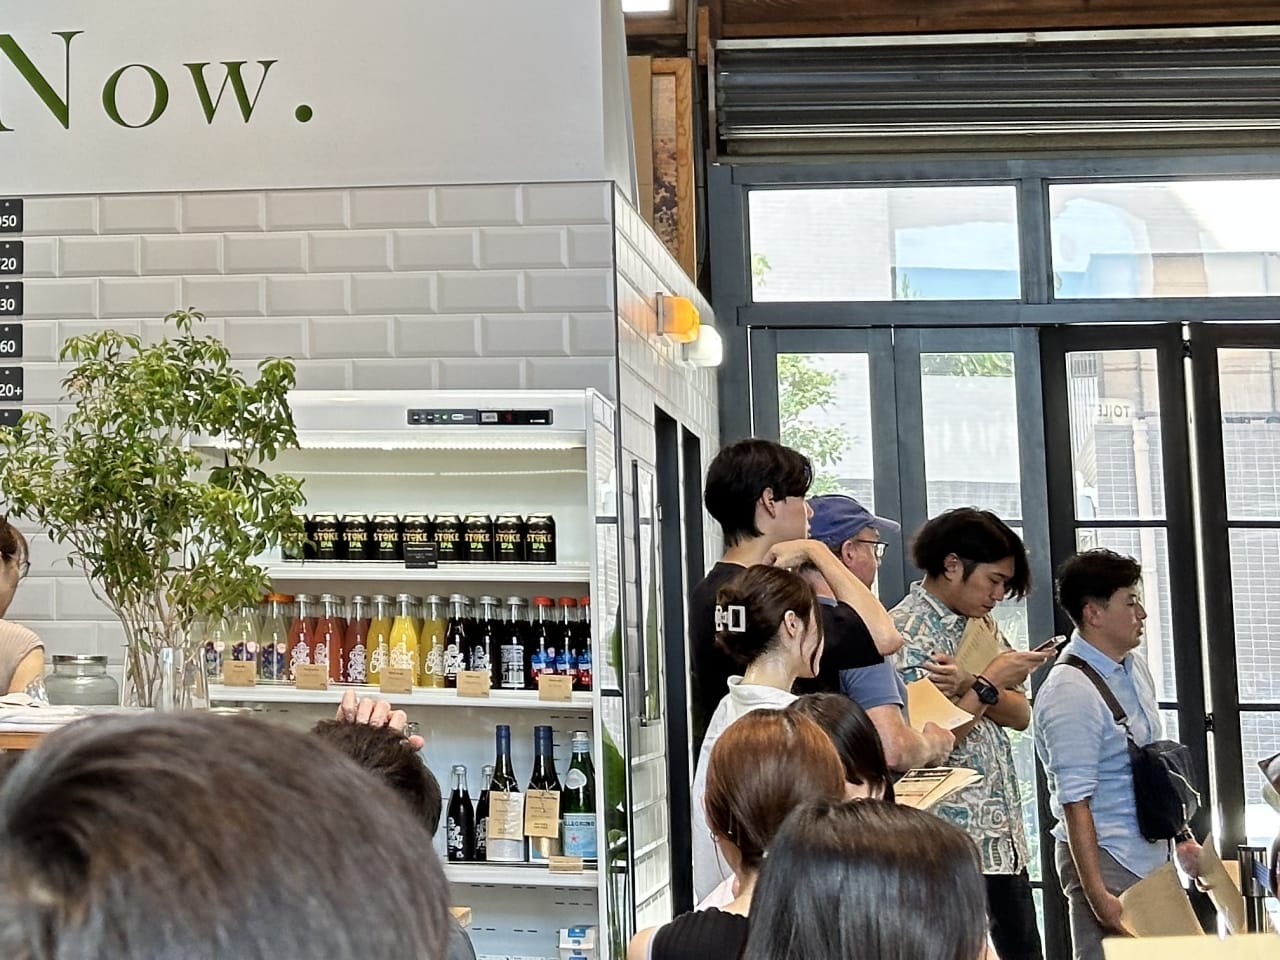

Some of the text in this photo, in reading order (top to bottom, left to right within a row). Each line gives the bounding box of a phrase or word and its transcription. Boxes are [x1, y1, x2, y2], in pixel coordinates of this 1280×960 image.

[402, 533, 428, 541] STOKE
[434, 533, 460, 541] STOKE
[464, 533, 490, 542] STOKE
[495, 534, 520, 542] STOKE
[526, 534, 552, 542] STOKE
